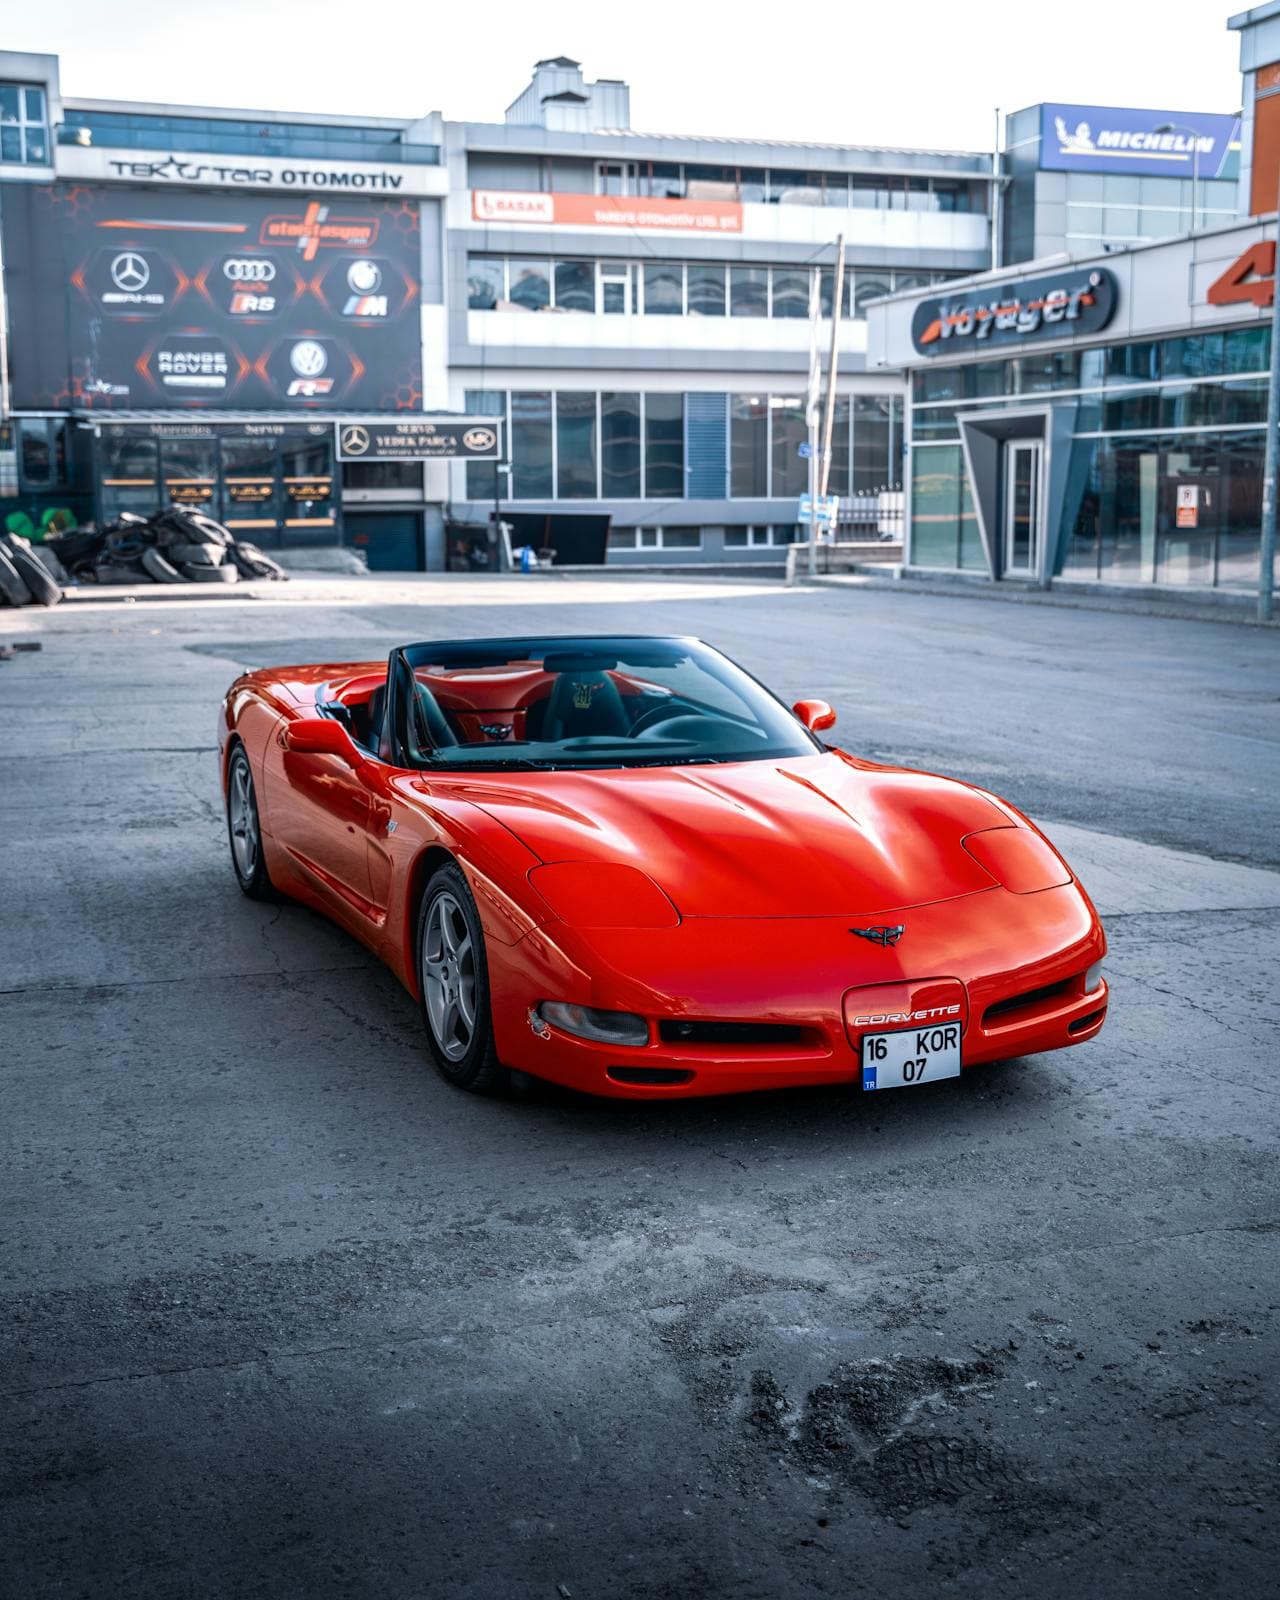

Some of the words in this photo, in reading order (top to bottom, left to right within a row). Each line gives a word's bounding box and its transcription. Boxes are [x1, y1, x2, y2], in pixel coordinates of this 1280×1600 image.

[1097, 130, 1215, 153] MICHELIN
[281, 169, 402, 189] OTOMOTİV
[936, 284, 1092, 340] Voyager
[157, 351, 227, 364] RANGE
[158, 362, 228, 374] ROVER
[853, 1003, 961, 1026] CORVETTE
[867, 1038, 888, 1061] 16
[916, 1027, 957, 1055] KOR
[903, 1058, 927, 1082] 07
[865, 1081, 876, 1089] TR
